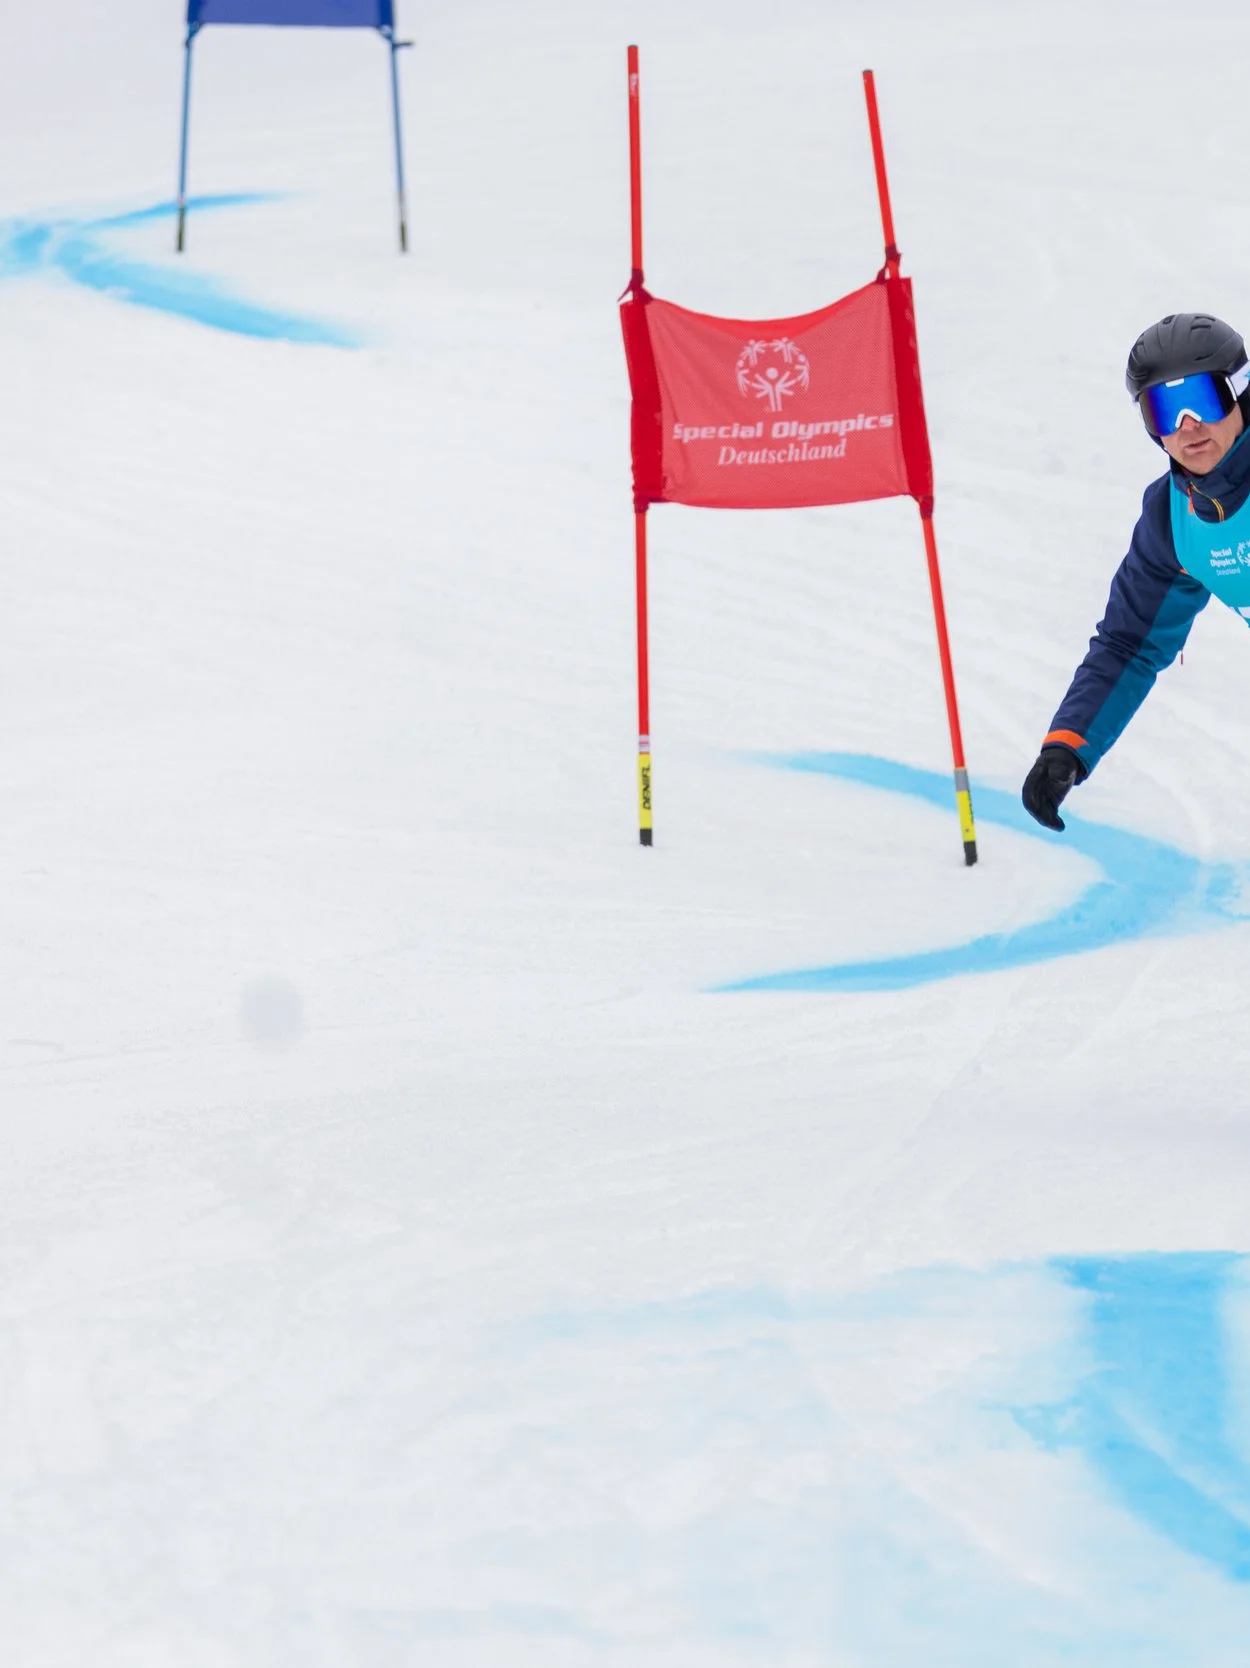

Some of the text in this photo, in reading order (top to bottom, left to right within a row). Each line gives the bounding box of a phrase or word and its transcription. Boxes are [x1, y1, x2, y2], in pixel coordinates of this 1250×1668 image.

[672, 412, 895, 444] Special Olympics
[717, 438, 847, 466] Deutschland
